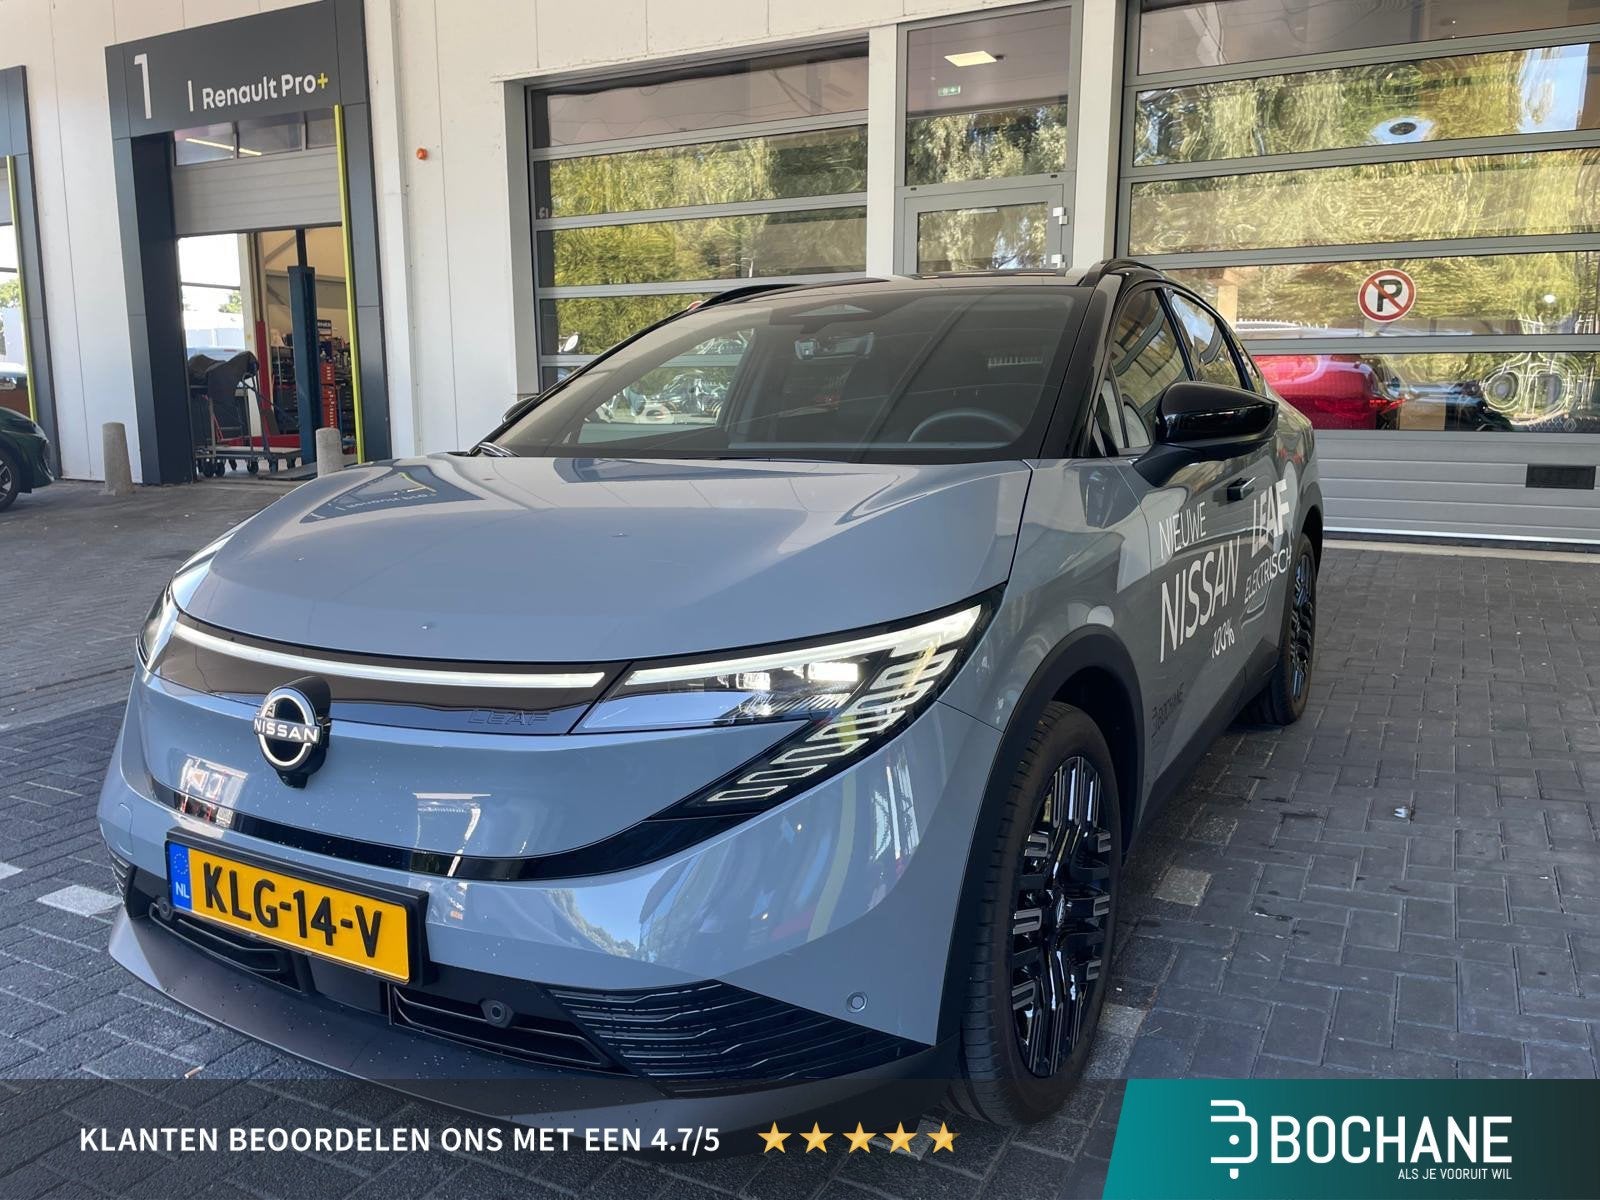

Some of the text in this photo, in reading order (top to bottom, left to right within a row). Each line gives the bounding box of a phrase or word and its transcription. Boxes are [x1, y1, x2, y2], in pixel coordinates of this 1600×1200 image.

[134, 53, 152, 119] 1
[202, 72, 329, 109] Renault Pro+
[1377, 279, 1403, 312] P
[1159, 502, 1207, 560] NIEUWE
[1160, 479, 1290, 663] NISSAN LEAF
[1211, 546, 1292, 659] 100% ELEKTRISCH
[254, 718, 318, 742] NISSAN
[467, 710, 549, 726] LEAF
[175, 881, 190, 899] NL
[203, 862, 382, 958] KLG-14-V
